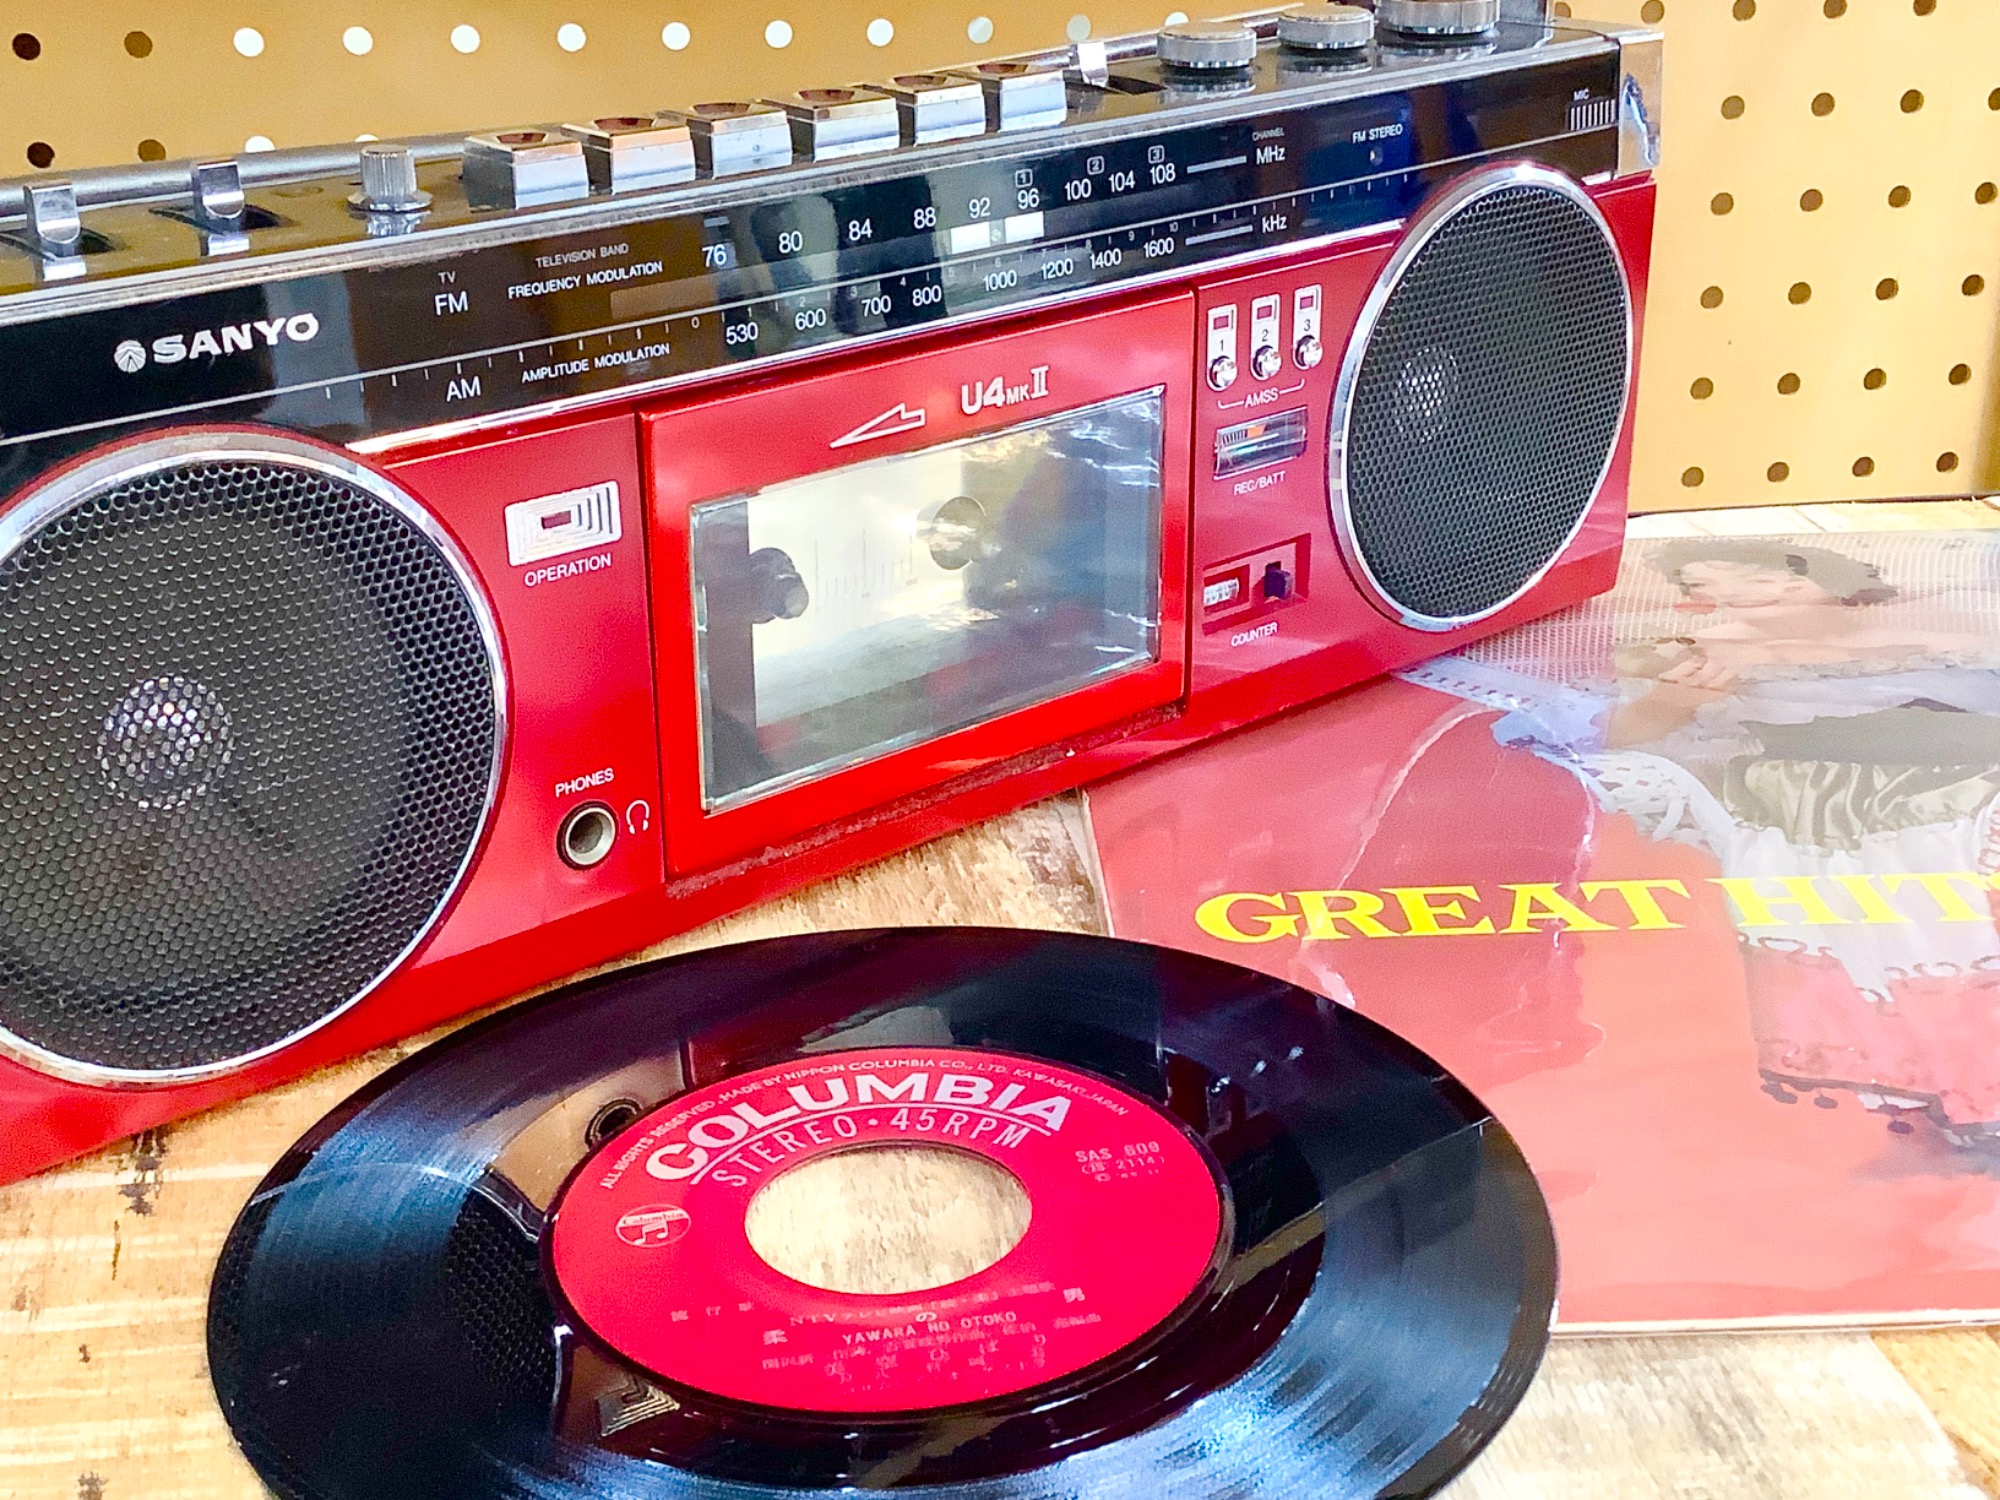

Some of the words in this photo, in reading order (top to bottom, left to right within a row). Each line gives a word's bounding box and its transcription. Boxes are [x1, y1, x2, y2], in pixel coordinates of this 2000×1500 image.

[1573, 88, 1590, 101] MIC
[1252, 127, 1285, 141] CHANNEL
[1352, 130, 1366, 144] FM
[1368, 123, 1403, 141] STEREO
[702, 244, 727, 267] 76
[778, 230, 803, 254] 80
[848, 218, 873, 241] 84
[913, 206, 937, 229] 88
[968, 197, 991, 219] 92
[1017, 188, 1040, 209] 96
[1064, 178, 1092, 201] 100
[1108, 170, 1136, 193] 104
[1149, 162, 1176, 185] 108
[1256, 145, 1286, 165] MHz
[535, 248, 596, 268] TELEVISION
[600, 242, 629, 256] BAND
[438, 270, 456, 284] TV
[508, 275, 581, 299] FREQUENCY
[586, 261, 663, 286] MODULATION
[726, 321, 759, 345] 530
[794, 308, 827, 331] 600
[861, 295, 892, 317] 700
[912, 284, 942, 307] 800
[983, 269, 1018, 291] 1000
[1041, 258, 1074, 280] 1200
[1089, 248, 1122, 270] 1400
[1143, 237, 1175, 259] 1600
[1261, 213, 1288, 234] kHz
[434, 290, 469, 316] FM
[152, 313, 320, 364] SANYO
[1262, 329, 1269, 342] 2
[1304, 318, 1312, 332] 3
[521, 358, 590, 384] AMPLITUDE
[593, 342, 670, 369] MODULATION
[446, 375, 481, 402] AM
[1245, 387, 1279, 408] AMSS
[1233, 470, 1286, 496] REC/BATT
[524, 552, 612, 588] OPERATION
[1231, 621, 1278, 647] COUNTER
[555, 767, 614, 798] PHONES
[1195, 878, 1691, 944] GREAT
[1703, 872, 1999, 928] HIT
[600, 1172, 622, 1190] ALL
[613, 1137, 654, 1172] RIGHTS
[763, 1074, 783, 1087] BY
[784, 1063, 845, 1080] NIPPON
[849, 1058, 936, 1071] COLUMBIA
[646, 1072, 1072, 1180] COLUMBIA
[711, 1114, 858, 1187] STEREO
[1075, 1147, 1112, 1162] SAS
[842, 1324, 917, 1344] YAWARA
[928, 1320, 951, 1334] NO
[960, 1311, 1017, 1329] OTOKO
